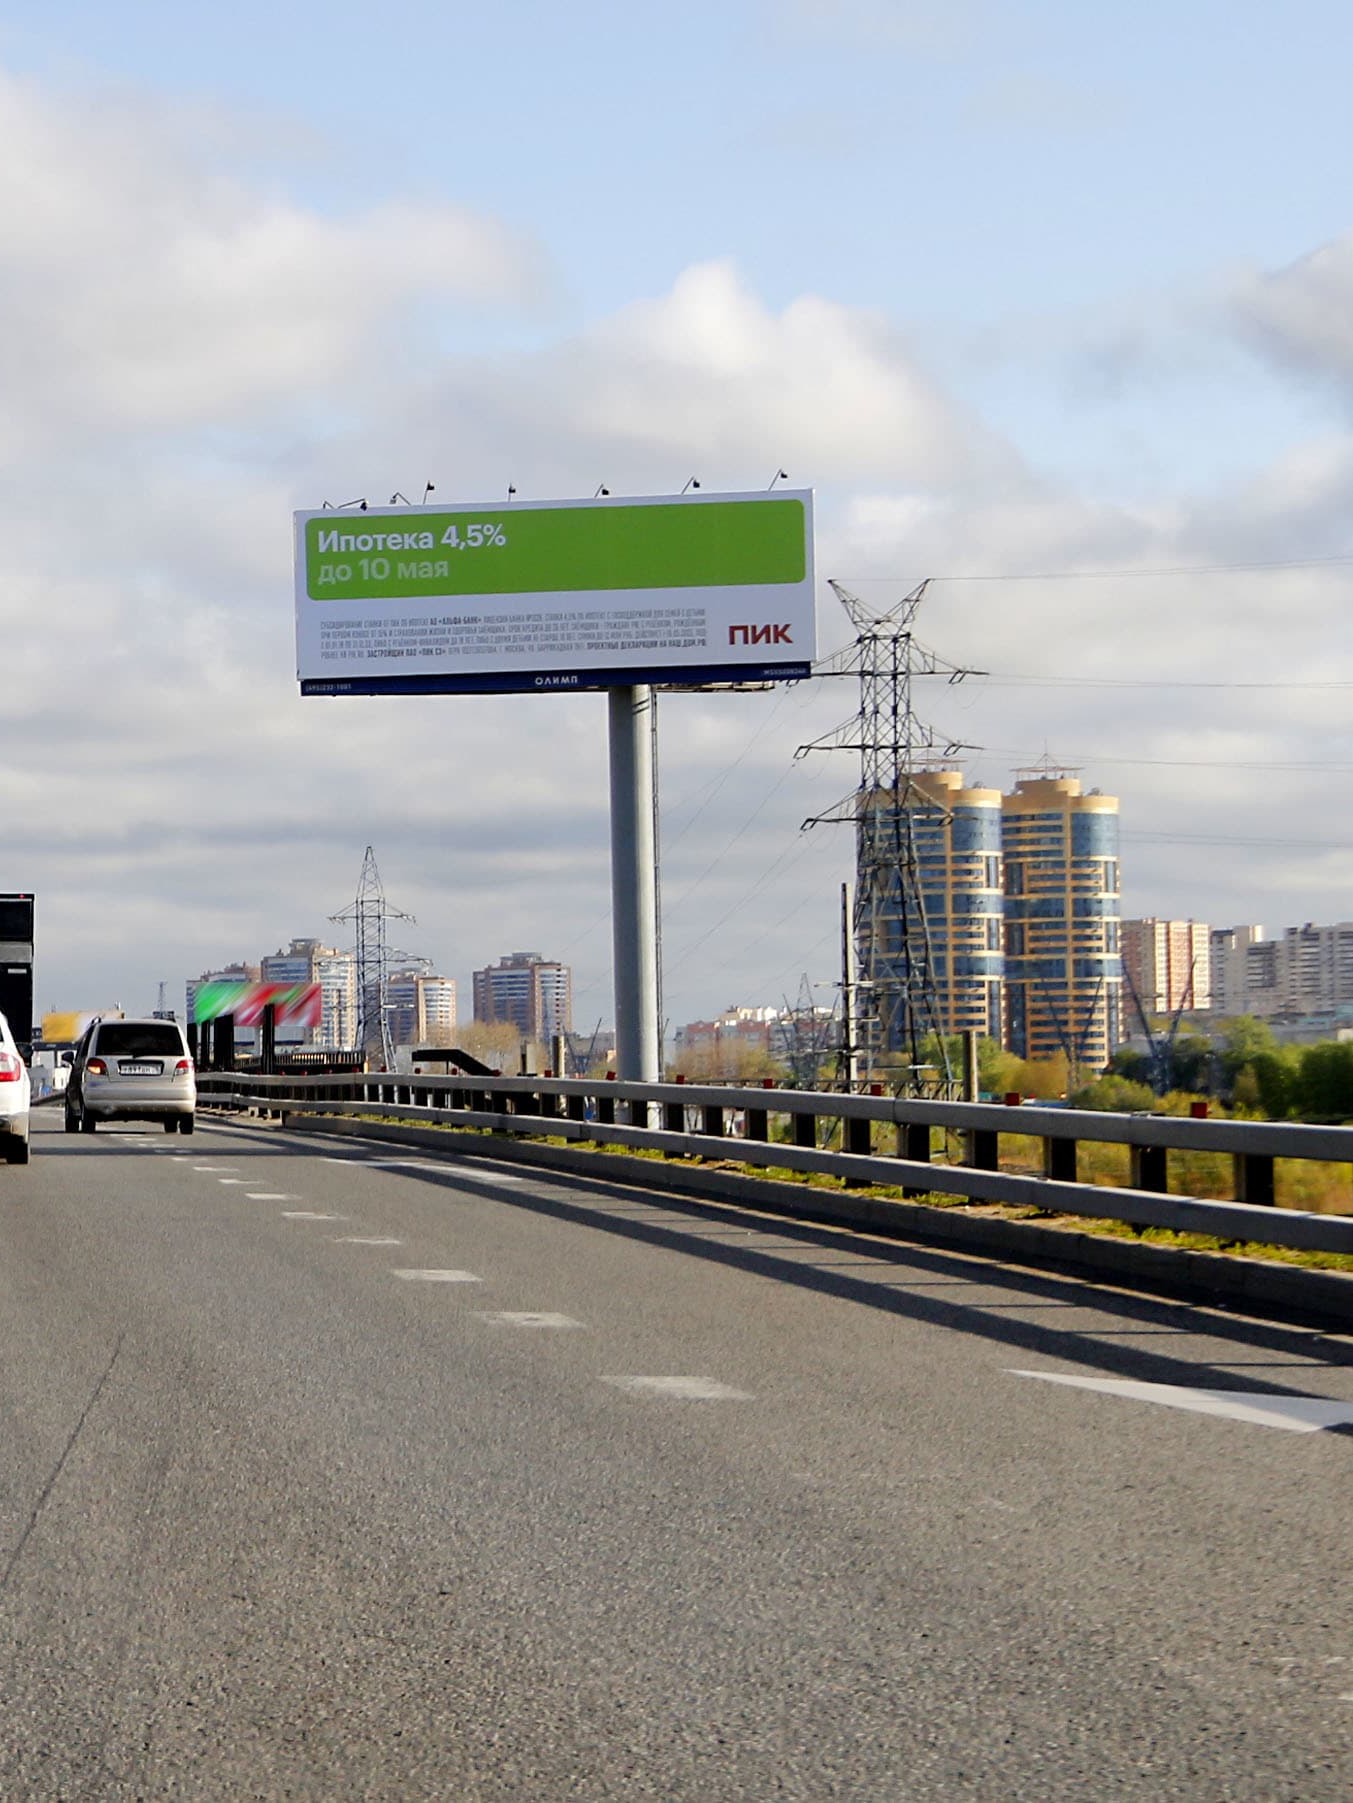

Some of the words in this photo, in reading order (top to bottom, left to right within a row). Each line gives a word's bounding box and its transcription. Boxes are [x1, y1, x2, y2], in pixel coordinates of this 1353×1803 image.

[318, 530, 434, 553] Ипотека
[440, 523, 507, 551] 4,5%
[318, 564, 352, 585] до
[358, 557, 391, 580] 10
[398, 560, 449, 579] мая
[728, 623, 794, 646] ПИК
[534, 675, 579, 686] ОЛИМП
